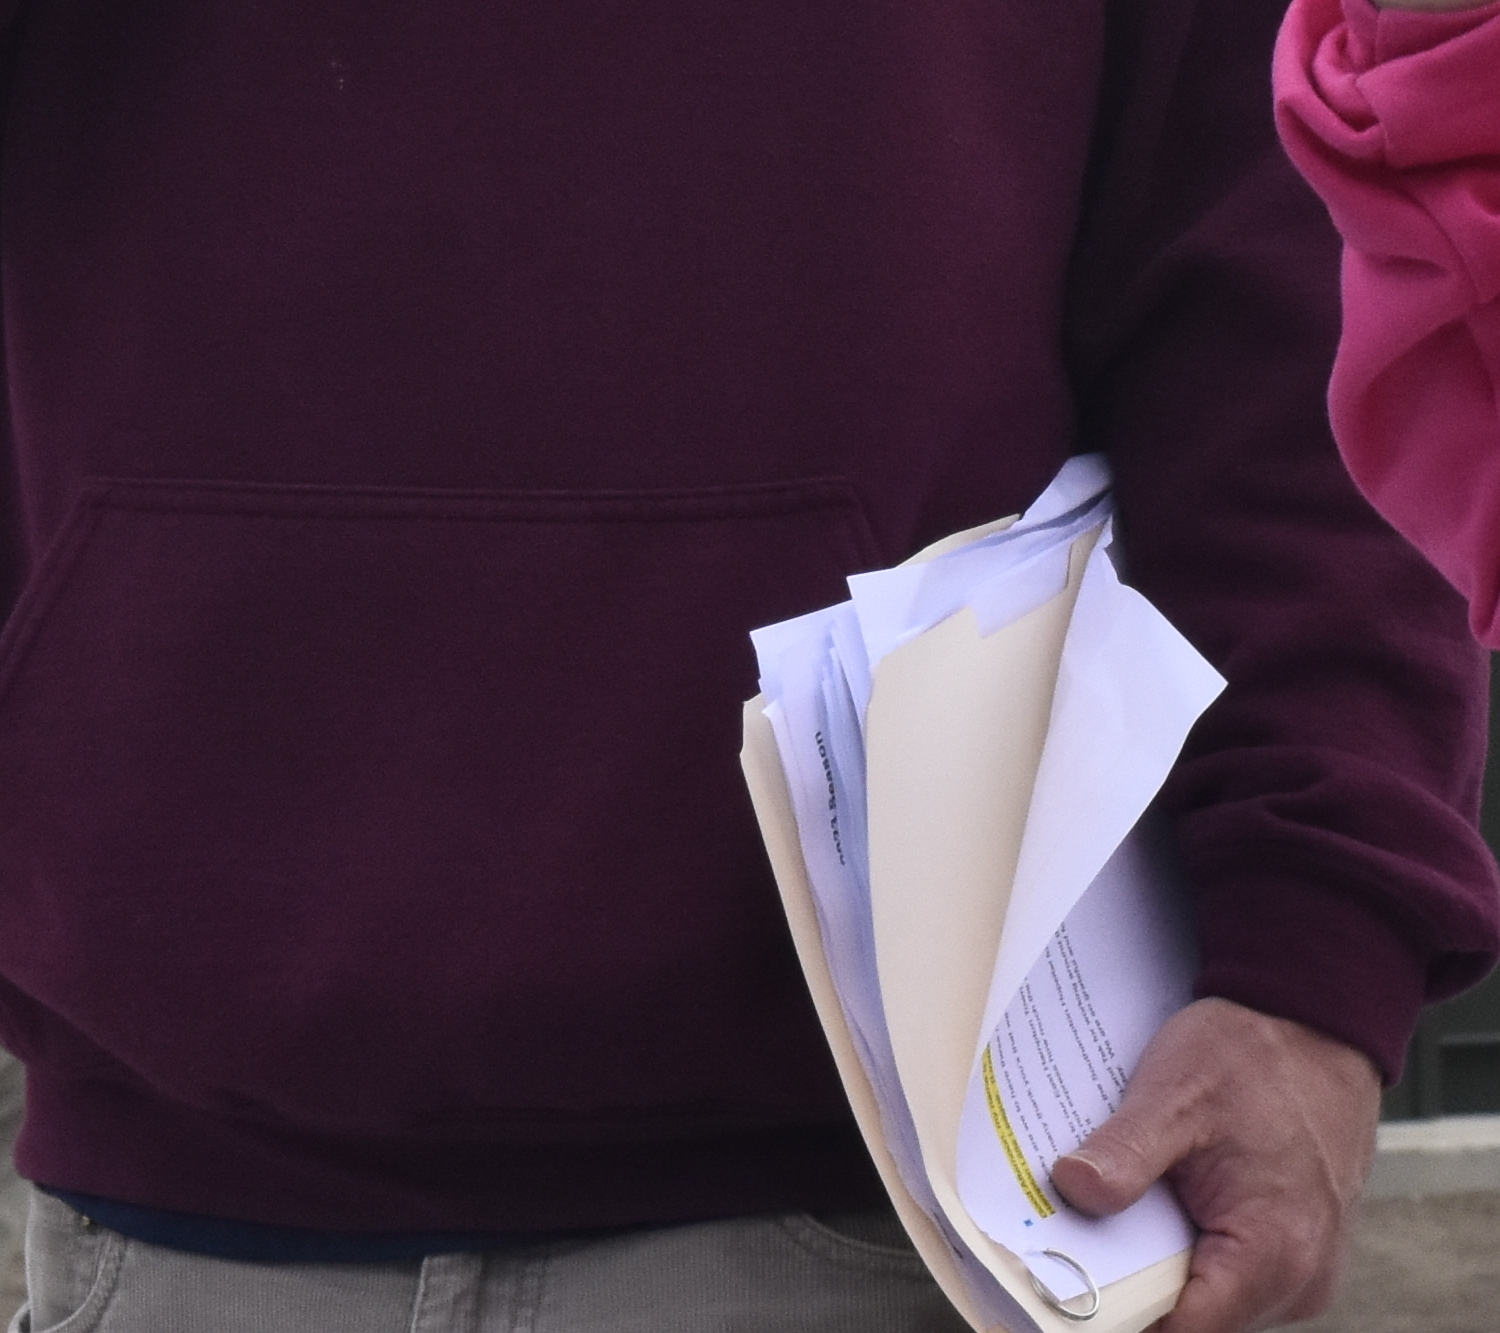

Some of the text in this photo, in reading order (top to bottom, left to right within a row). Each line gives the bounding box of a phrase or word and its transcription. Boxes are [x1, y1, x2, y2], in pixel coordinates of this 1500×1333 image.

[814, 731, 837, 811] Season
[1069, 957, 1091, 1002] grateful
[1007, 1031, 1018, 1054] that
[1039, 1120, 1060, 1152] many
